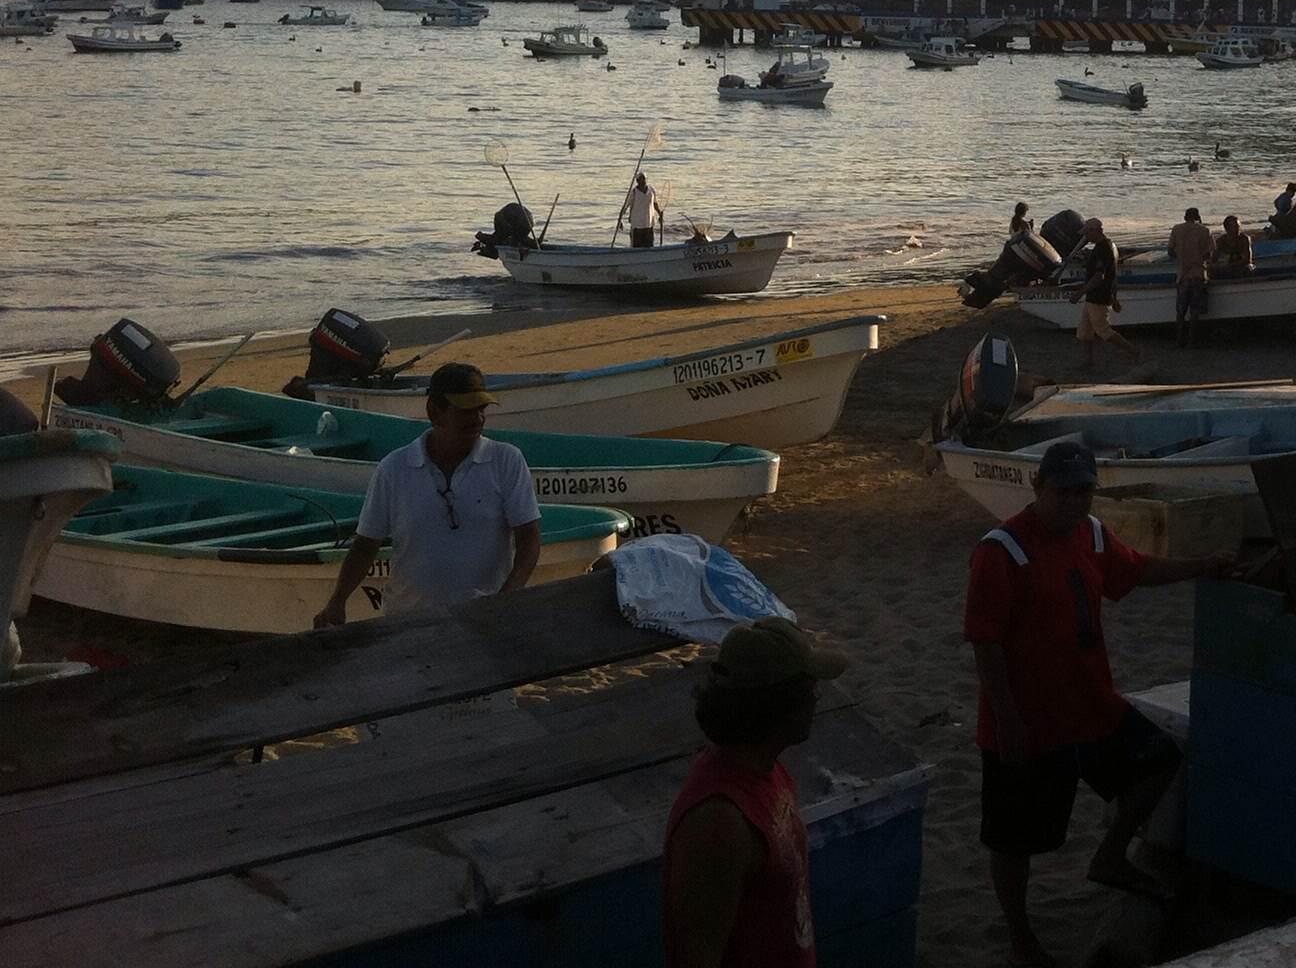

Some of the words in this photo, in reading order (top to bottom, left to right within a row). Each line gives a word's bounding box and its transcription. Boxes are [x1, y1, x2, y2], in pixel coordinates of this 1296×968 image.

[691, 259, 732, 273] PATRICIA
[686, 381, 731, 401] DOÑA
[730, 369, 782, 391] MARY
